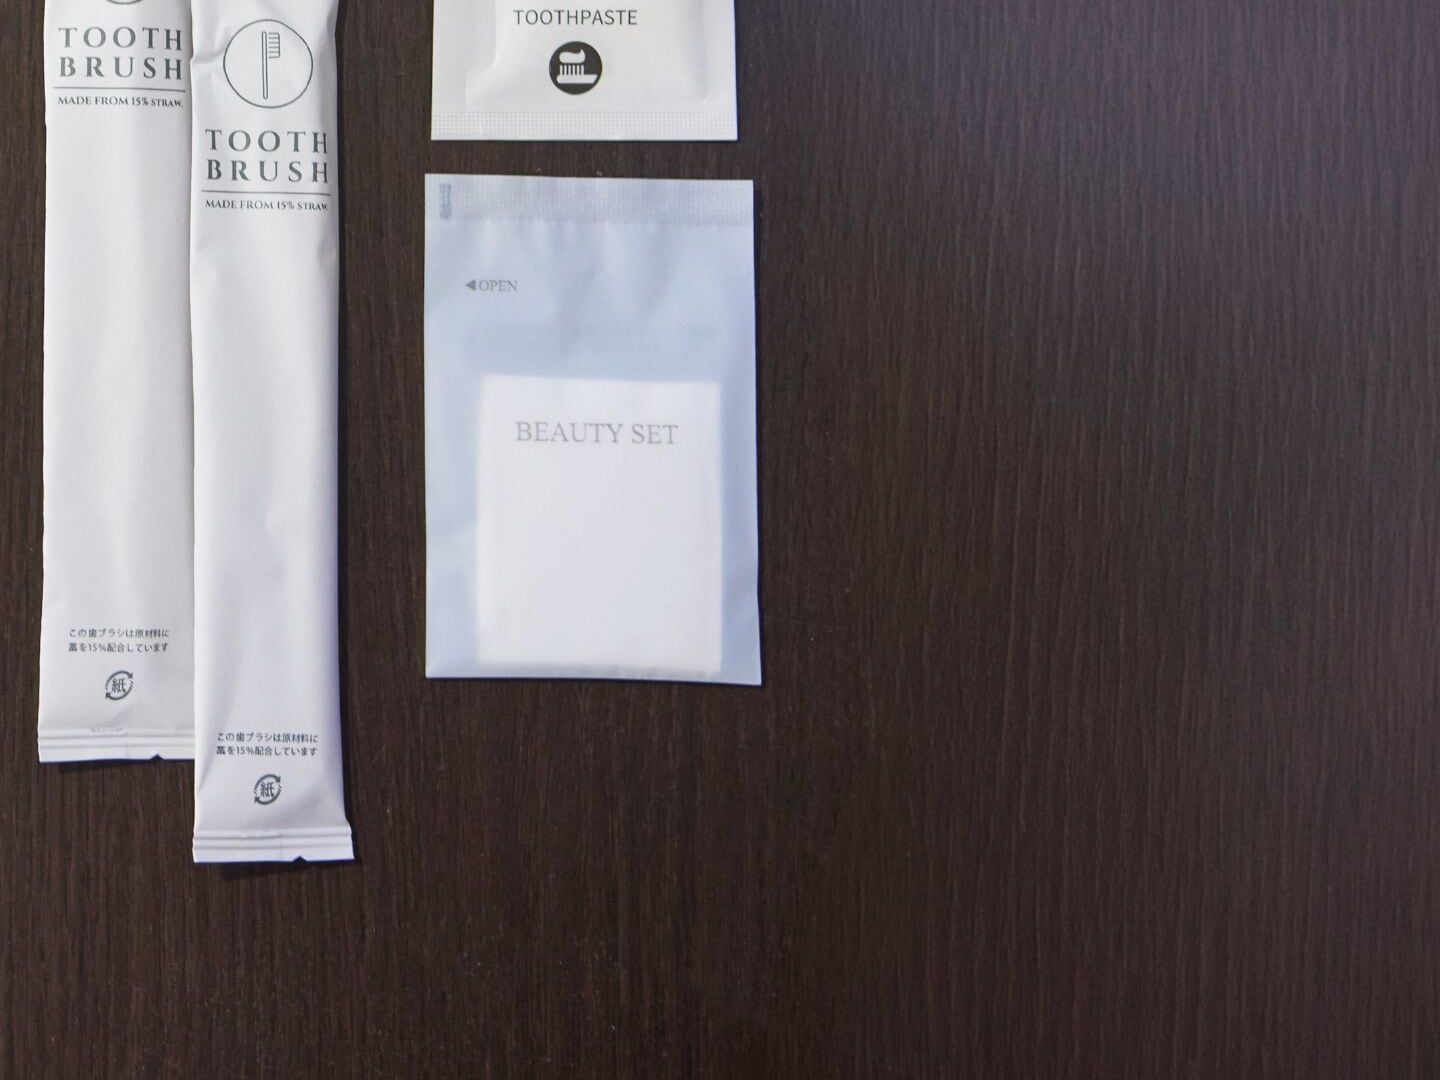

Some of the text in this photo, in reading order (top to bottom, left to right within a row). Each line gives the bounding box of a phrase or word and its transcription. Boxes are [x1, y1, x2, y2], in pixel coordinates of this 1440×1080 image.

[513, 9, 638, 26] TOOTHPASTE
[58, 26, 182, 51] TOOTH
[59, 56, 182, 80] BRUSH
[58, 96, 91, 106] MADE
[95, 96, 128, 106] FROM
[131, 96, 149, 106] 15%
[205, 129, 327, 154] TOOTH
[206, 159, 328, 184] BRUSH
[205, 199, 237, 209] MADE
[240, 200, 273, 210] FROM
[277, 200, 294, 210] 15%
[479, 279, 518, 293] OPEN
[515, 420, 679, 446] BEAUTY SET
[68, 628, 171, 639] この歯ブラシは原材料に
[216, 732, 319, 743] この歯ブラシは原材料に
